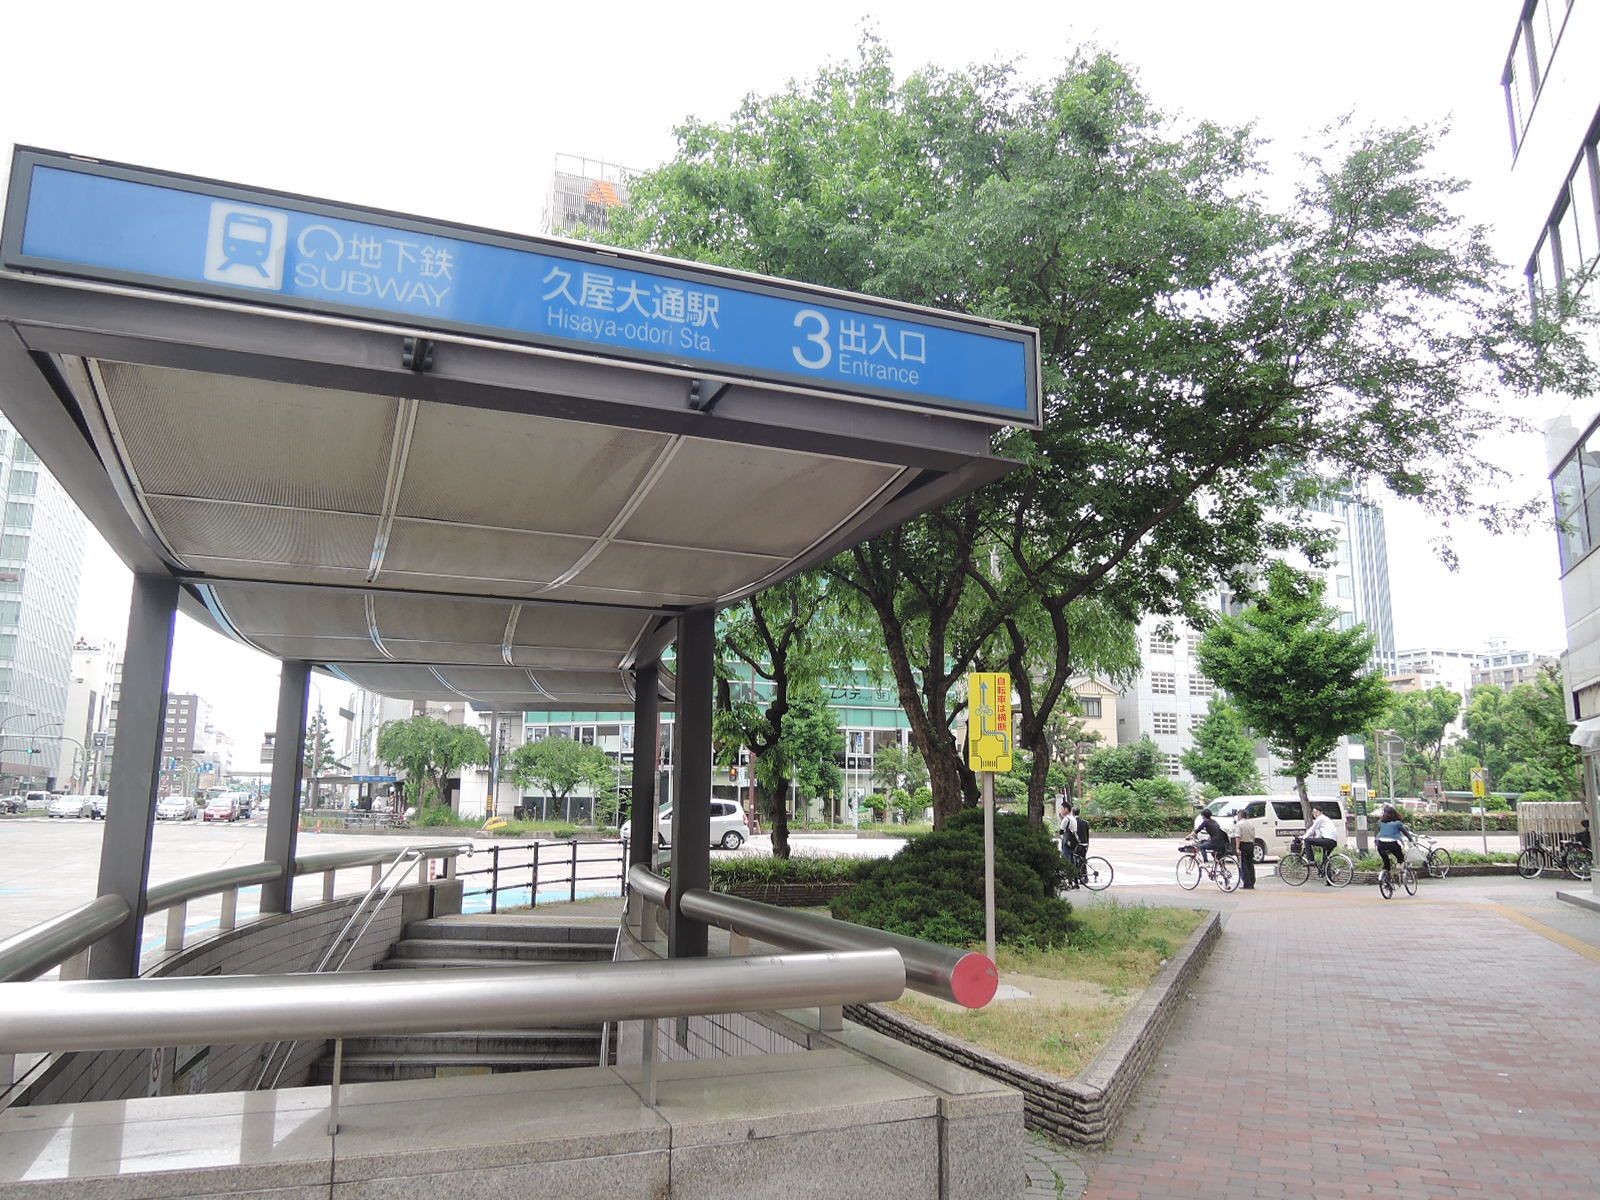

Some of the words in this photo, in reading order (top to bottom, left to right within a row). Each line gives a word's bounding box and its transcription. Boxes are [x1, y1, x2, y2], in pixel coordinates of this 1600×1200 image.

[347, 232, 454, 281] 地下鉄
[293, 262, 450, 308] SUBWAY
[542, 265, 720, 330] 久屋大通駅
[547, 305, 673, 346] Hisaya-odori
[679, 327, 716, 352] Sta.
[792, 309, 832, 370] 3
[839, 319, 926, 364] 出入口
[839, 353, 920, 385] Entrance
[997, 677, 1007, 731] 自転車は横断
